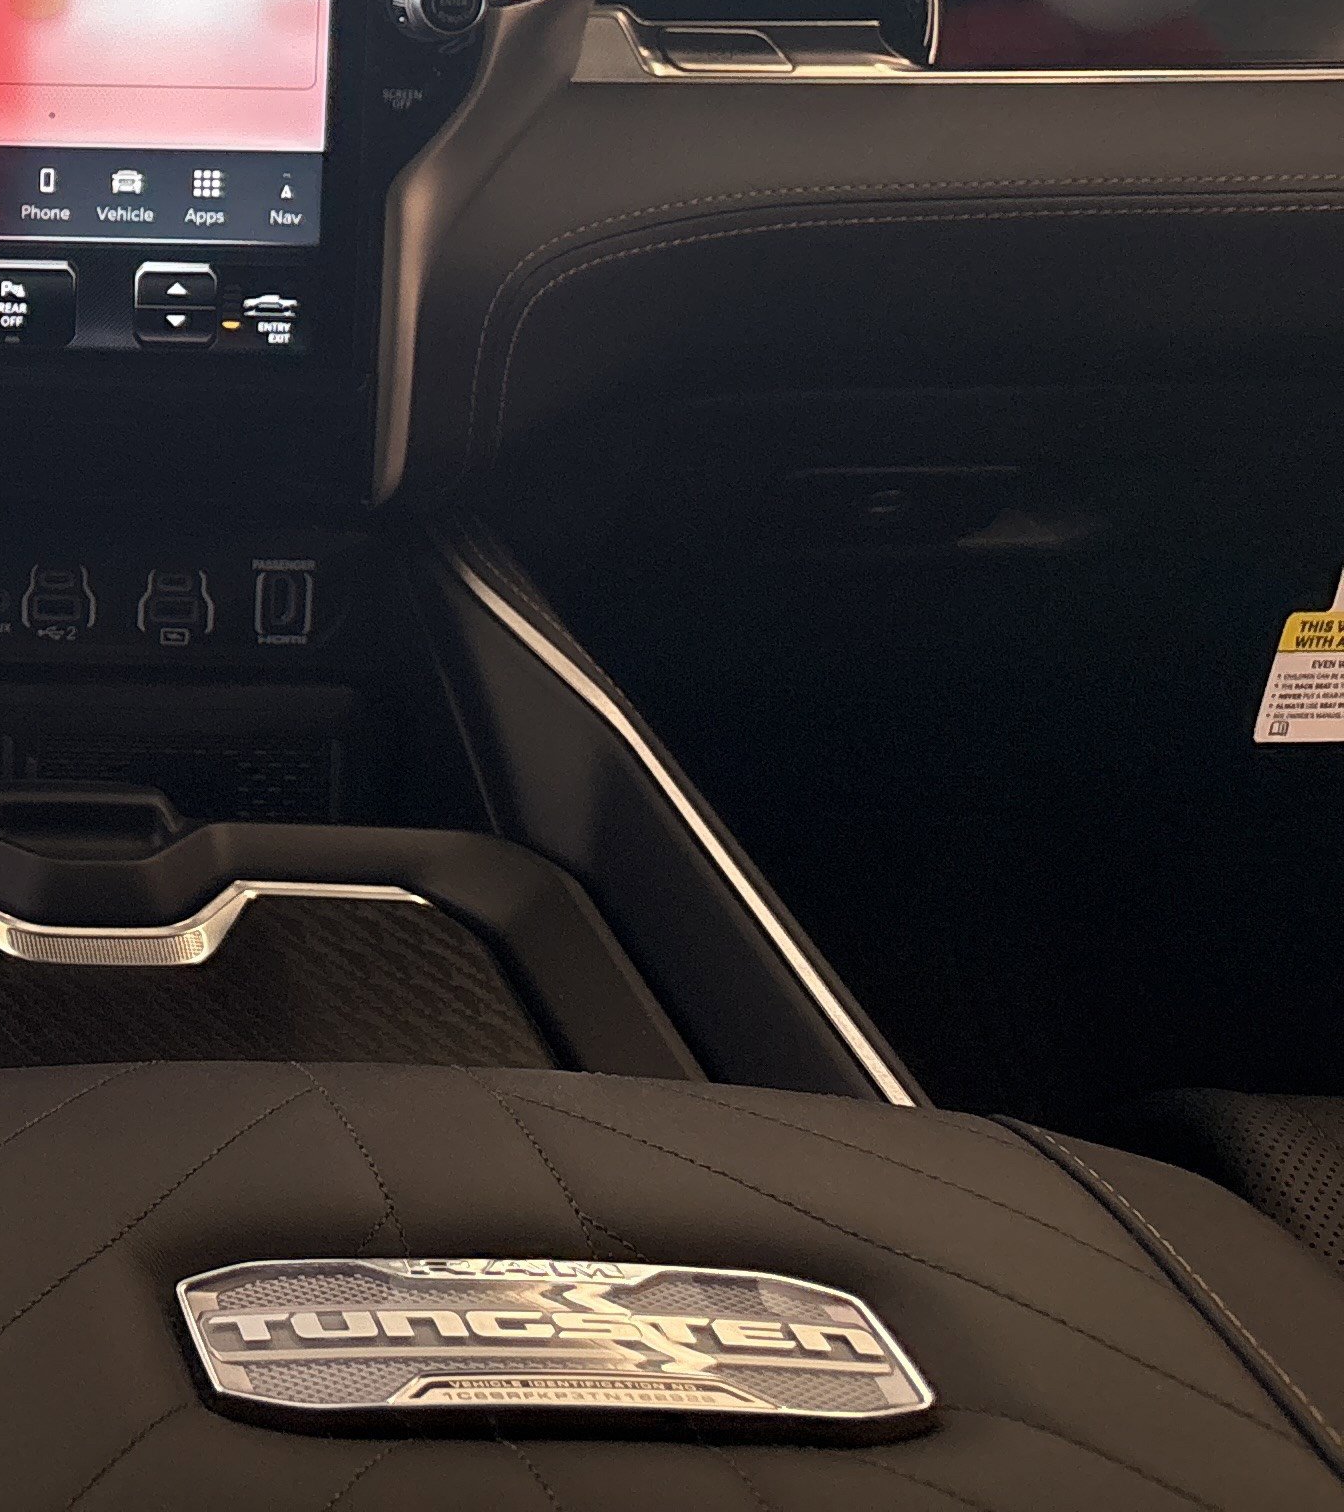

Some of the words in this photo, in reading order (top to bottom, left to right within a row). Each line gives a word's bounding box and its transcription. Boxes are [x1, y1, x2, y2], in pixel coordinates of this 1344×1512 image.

[21, 204, 70, 222] Phone
[96, 205, 154, 223] Vehicle
[184, 208, 225, 228] Apps
[269, 209, 303, 226] Nav
[0, 315, 24, 328] OFF
[257, 321, 291, 333] ENTRY
[267, 332, 291, 344] EXIT
[1300, 620, 1334, 633] THIS
[1295, 635, 1334, 649] WITH
[408, 1259, 624, 1279] RAM
[210, 1310, 887, 1355] TUNGSTEN
[448, 1379, 522, 1389] VEHICLE
[528, 1379, 665, 1391] IDENTIFICATION
